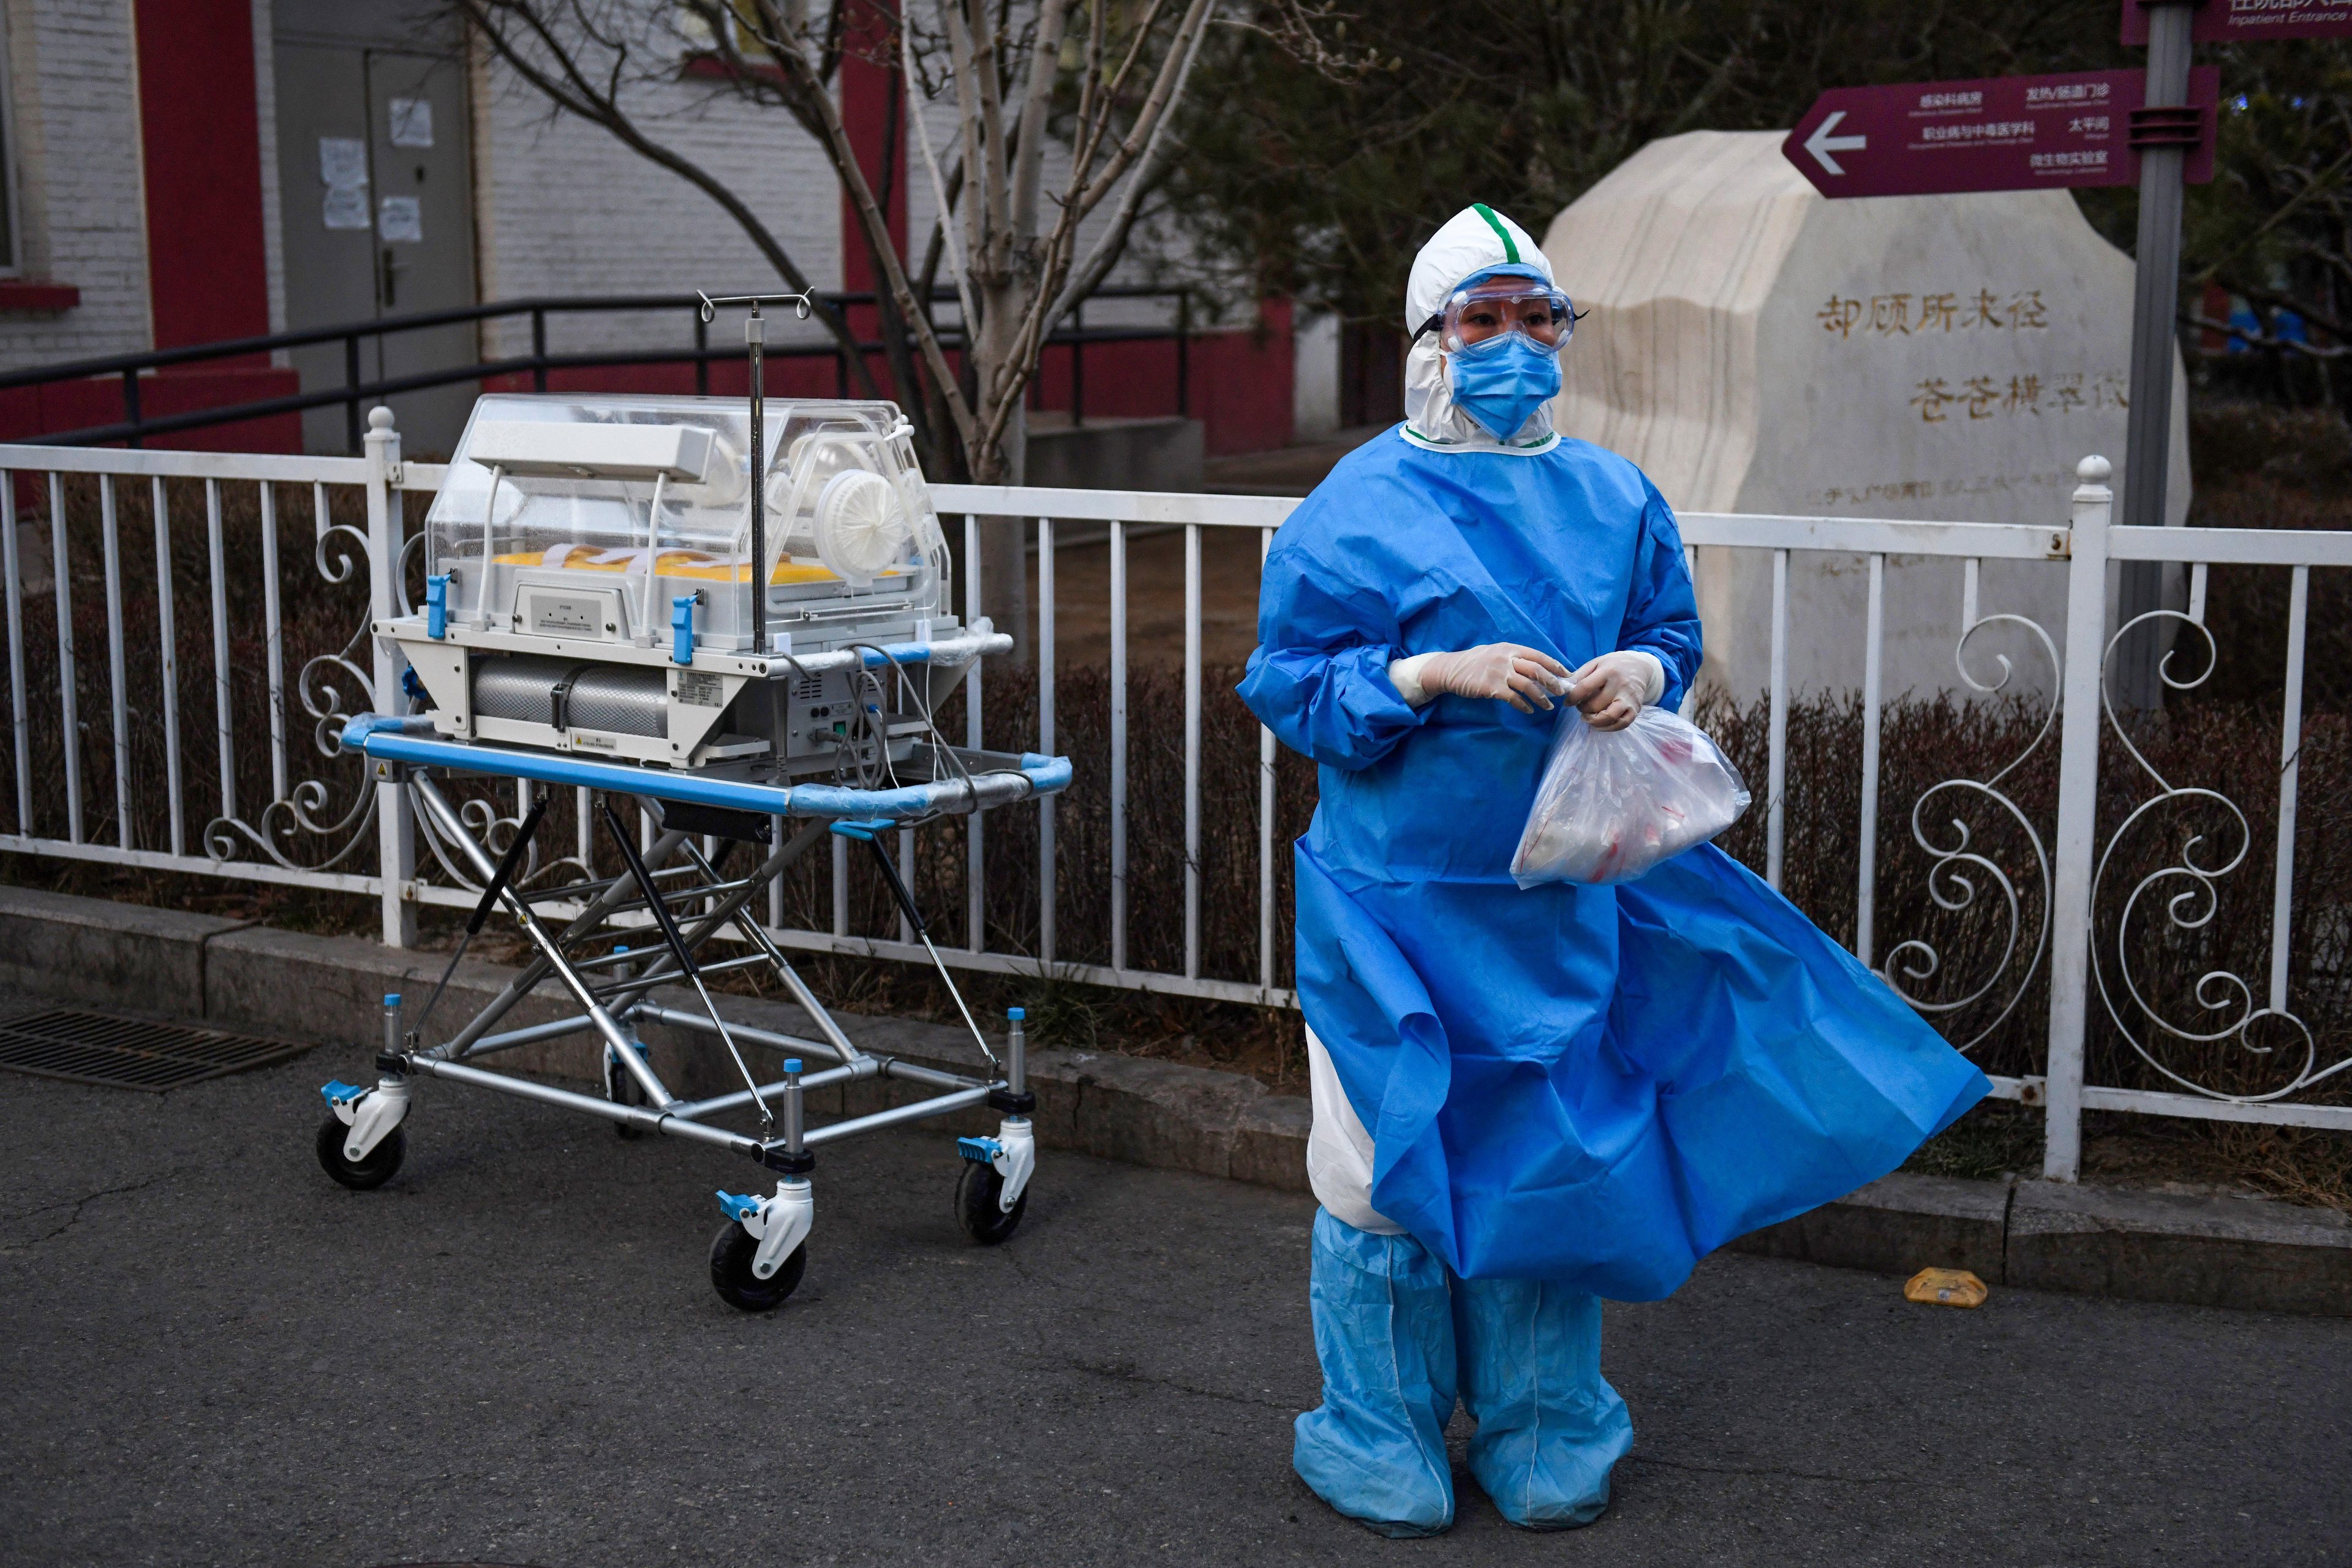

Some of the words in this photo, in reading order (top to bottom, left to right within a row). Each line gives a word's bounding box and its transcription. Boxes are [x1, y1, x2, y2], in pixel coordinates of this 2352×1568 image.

[2228, 14, 2285, 27] Inpatient
[2288, 11, 2347, 23] Entrance
[1817, 287, 2049, 341] 却顾所来径
